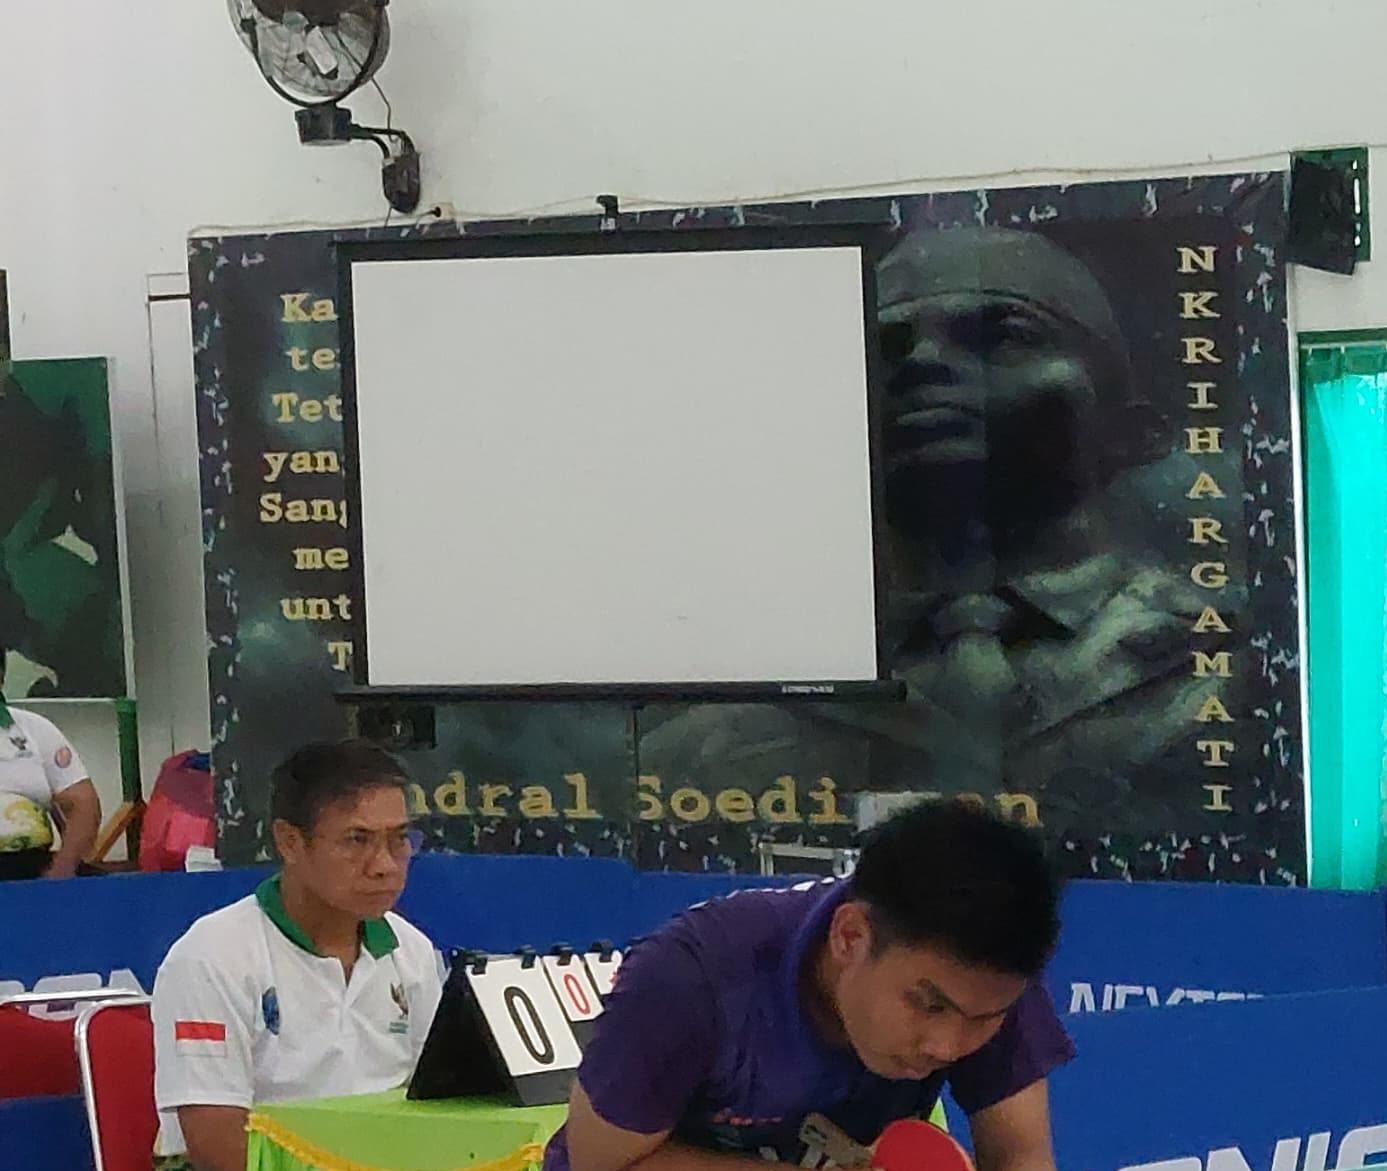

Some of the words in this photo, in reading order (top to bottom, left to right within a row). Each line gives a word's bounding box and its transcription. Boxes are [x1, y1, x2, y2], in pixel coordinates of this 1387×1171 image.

[263, 451, 346, 483] yan
[563, 973, 592, 1015] 0
[503, 986, 555, 1065] 0
